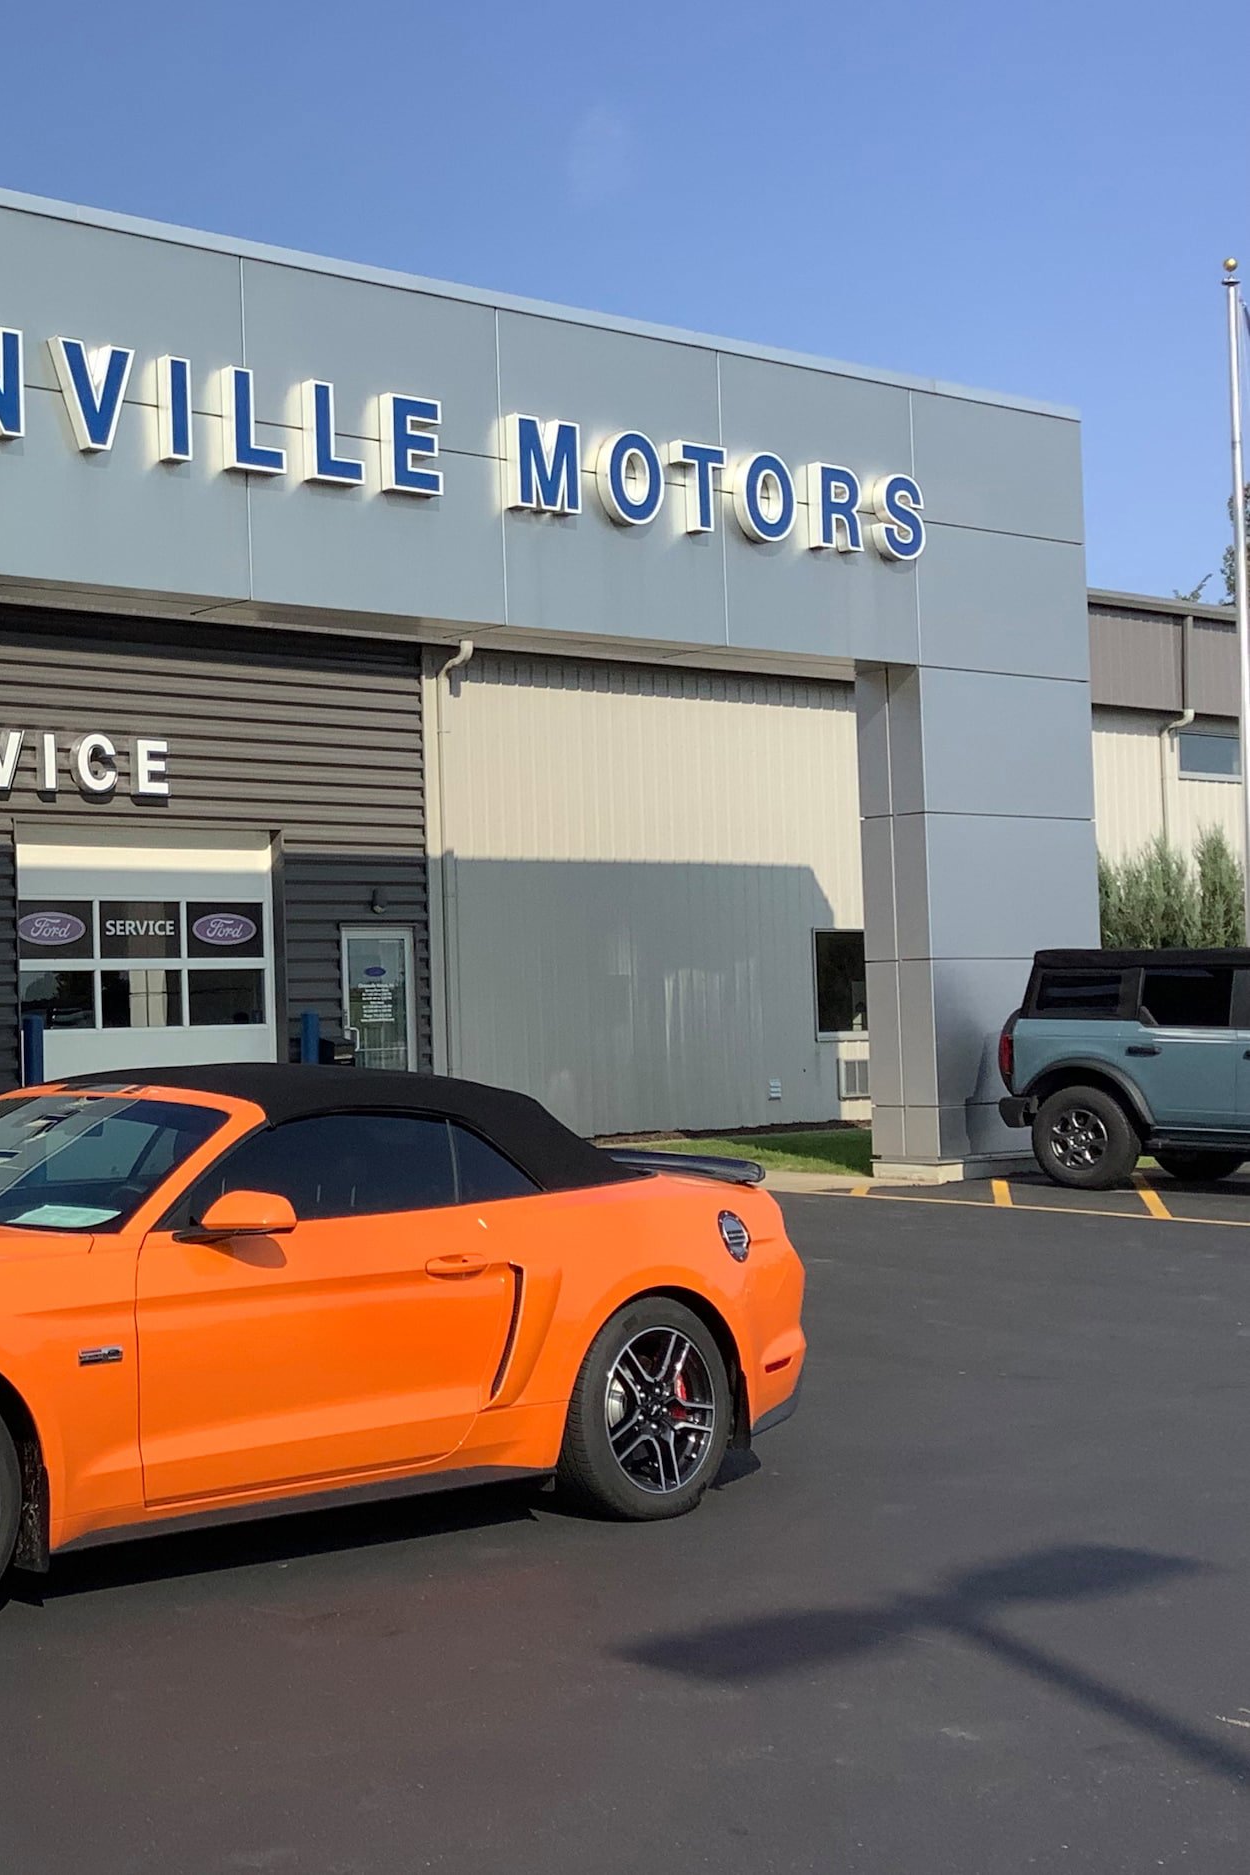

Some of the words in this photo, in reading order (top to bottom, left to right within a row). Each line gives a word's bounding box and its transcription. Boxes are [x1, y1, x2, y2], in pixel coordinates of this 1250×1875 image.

[504, 412, 927, 561] MOTORS
[30, 917, 71, 939] Ford
[105, 919, 175, 936] SERVICE
[206, 917, 243, 939] Ford
